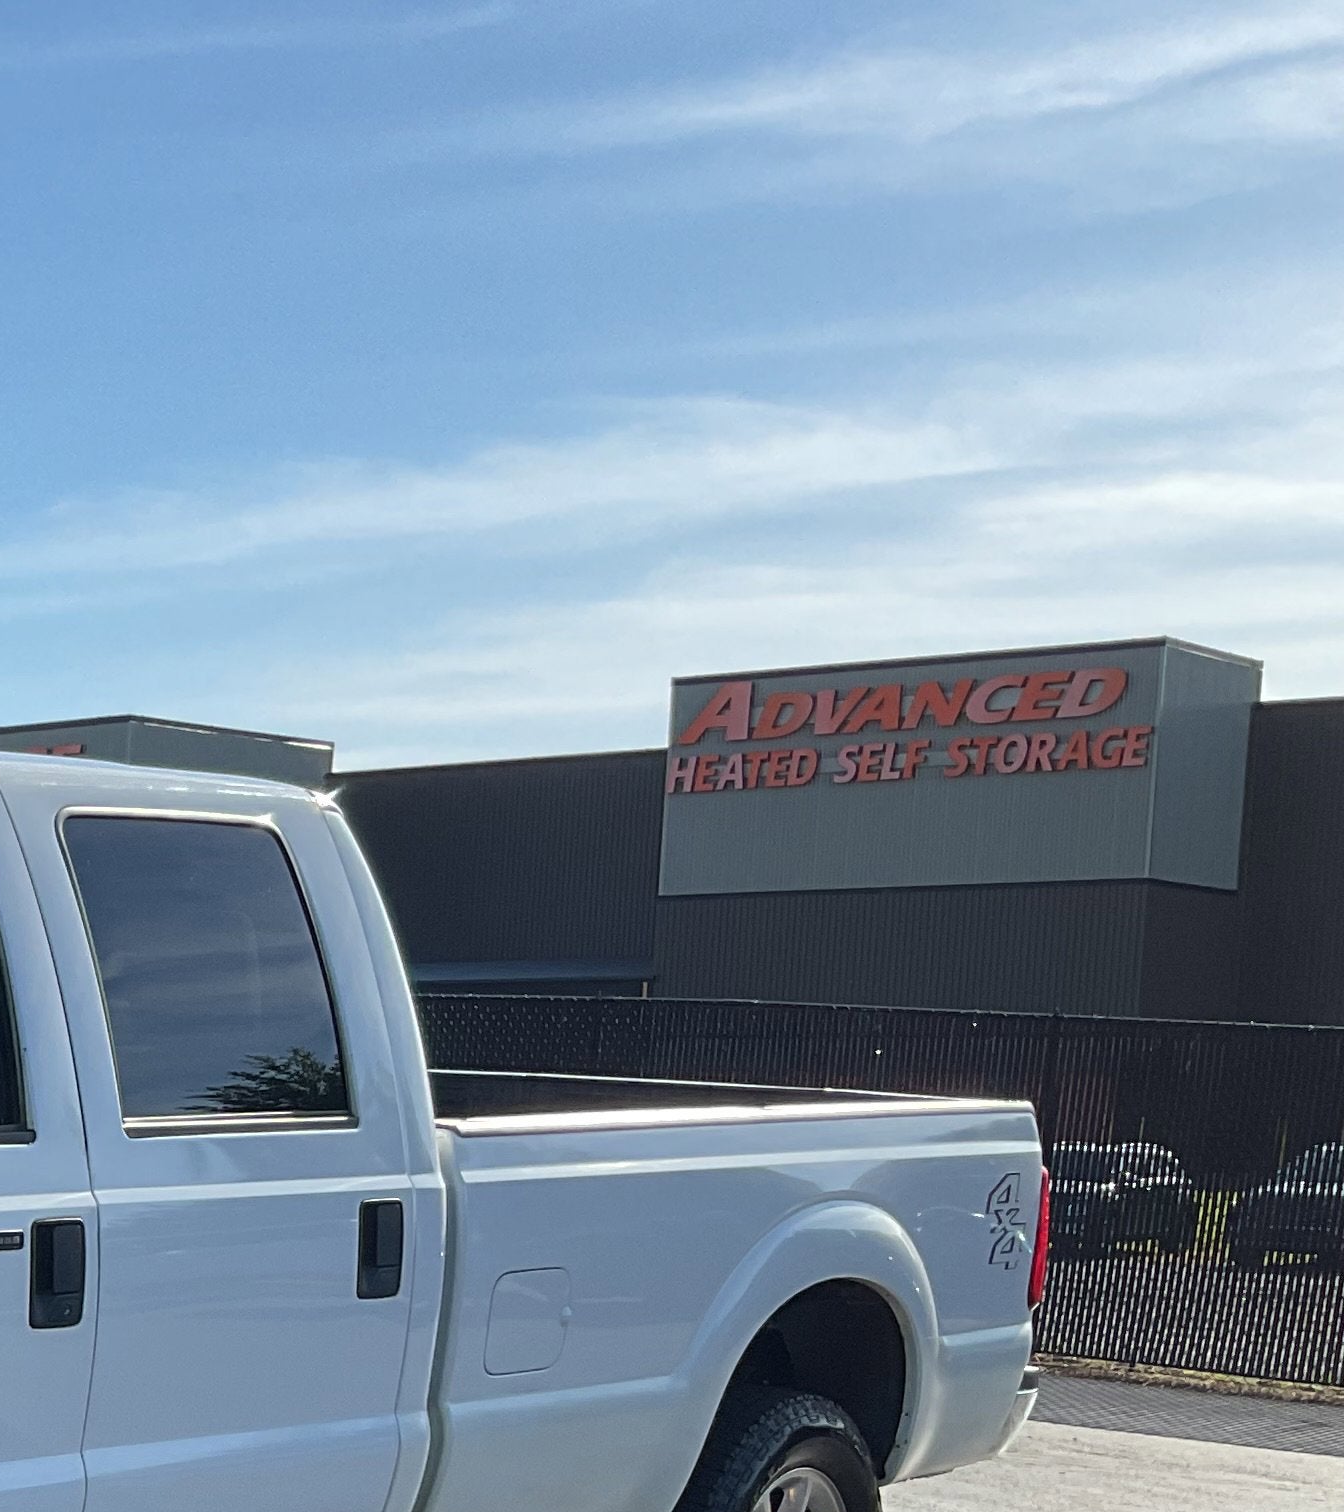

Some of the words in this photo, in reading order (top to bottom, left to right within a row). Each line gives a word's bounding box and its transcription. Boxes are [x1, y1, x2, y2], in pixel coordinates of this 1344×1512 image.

[679, 668, 1129, 746] ADVANCED
[667, 748, 819, 793] HEATED
[833, 739, 930, 784] SELF
[943, 726, 1154, 779] STORAGE
